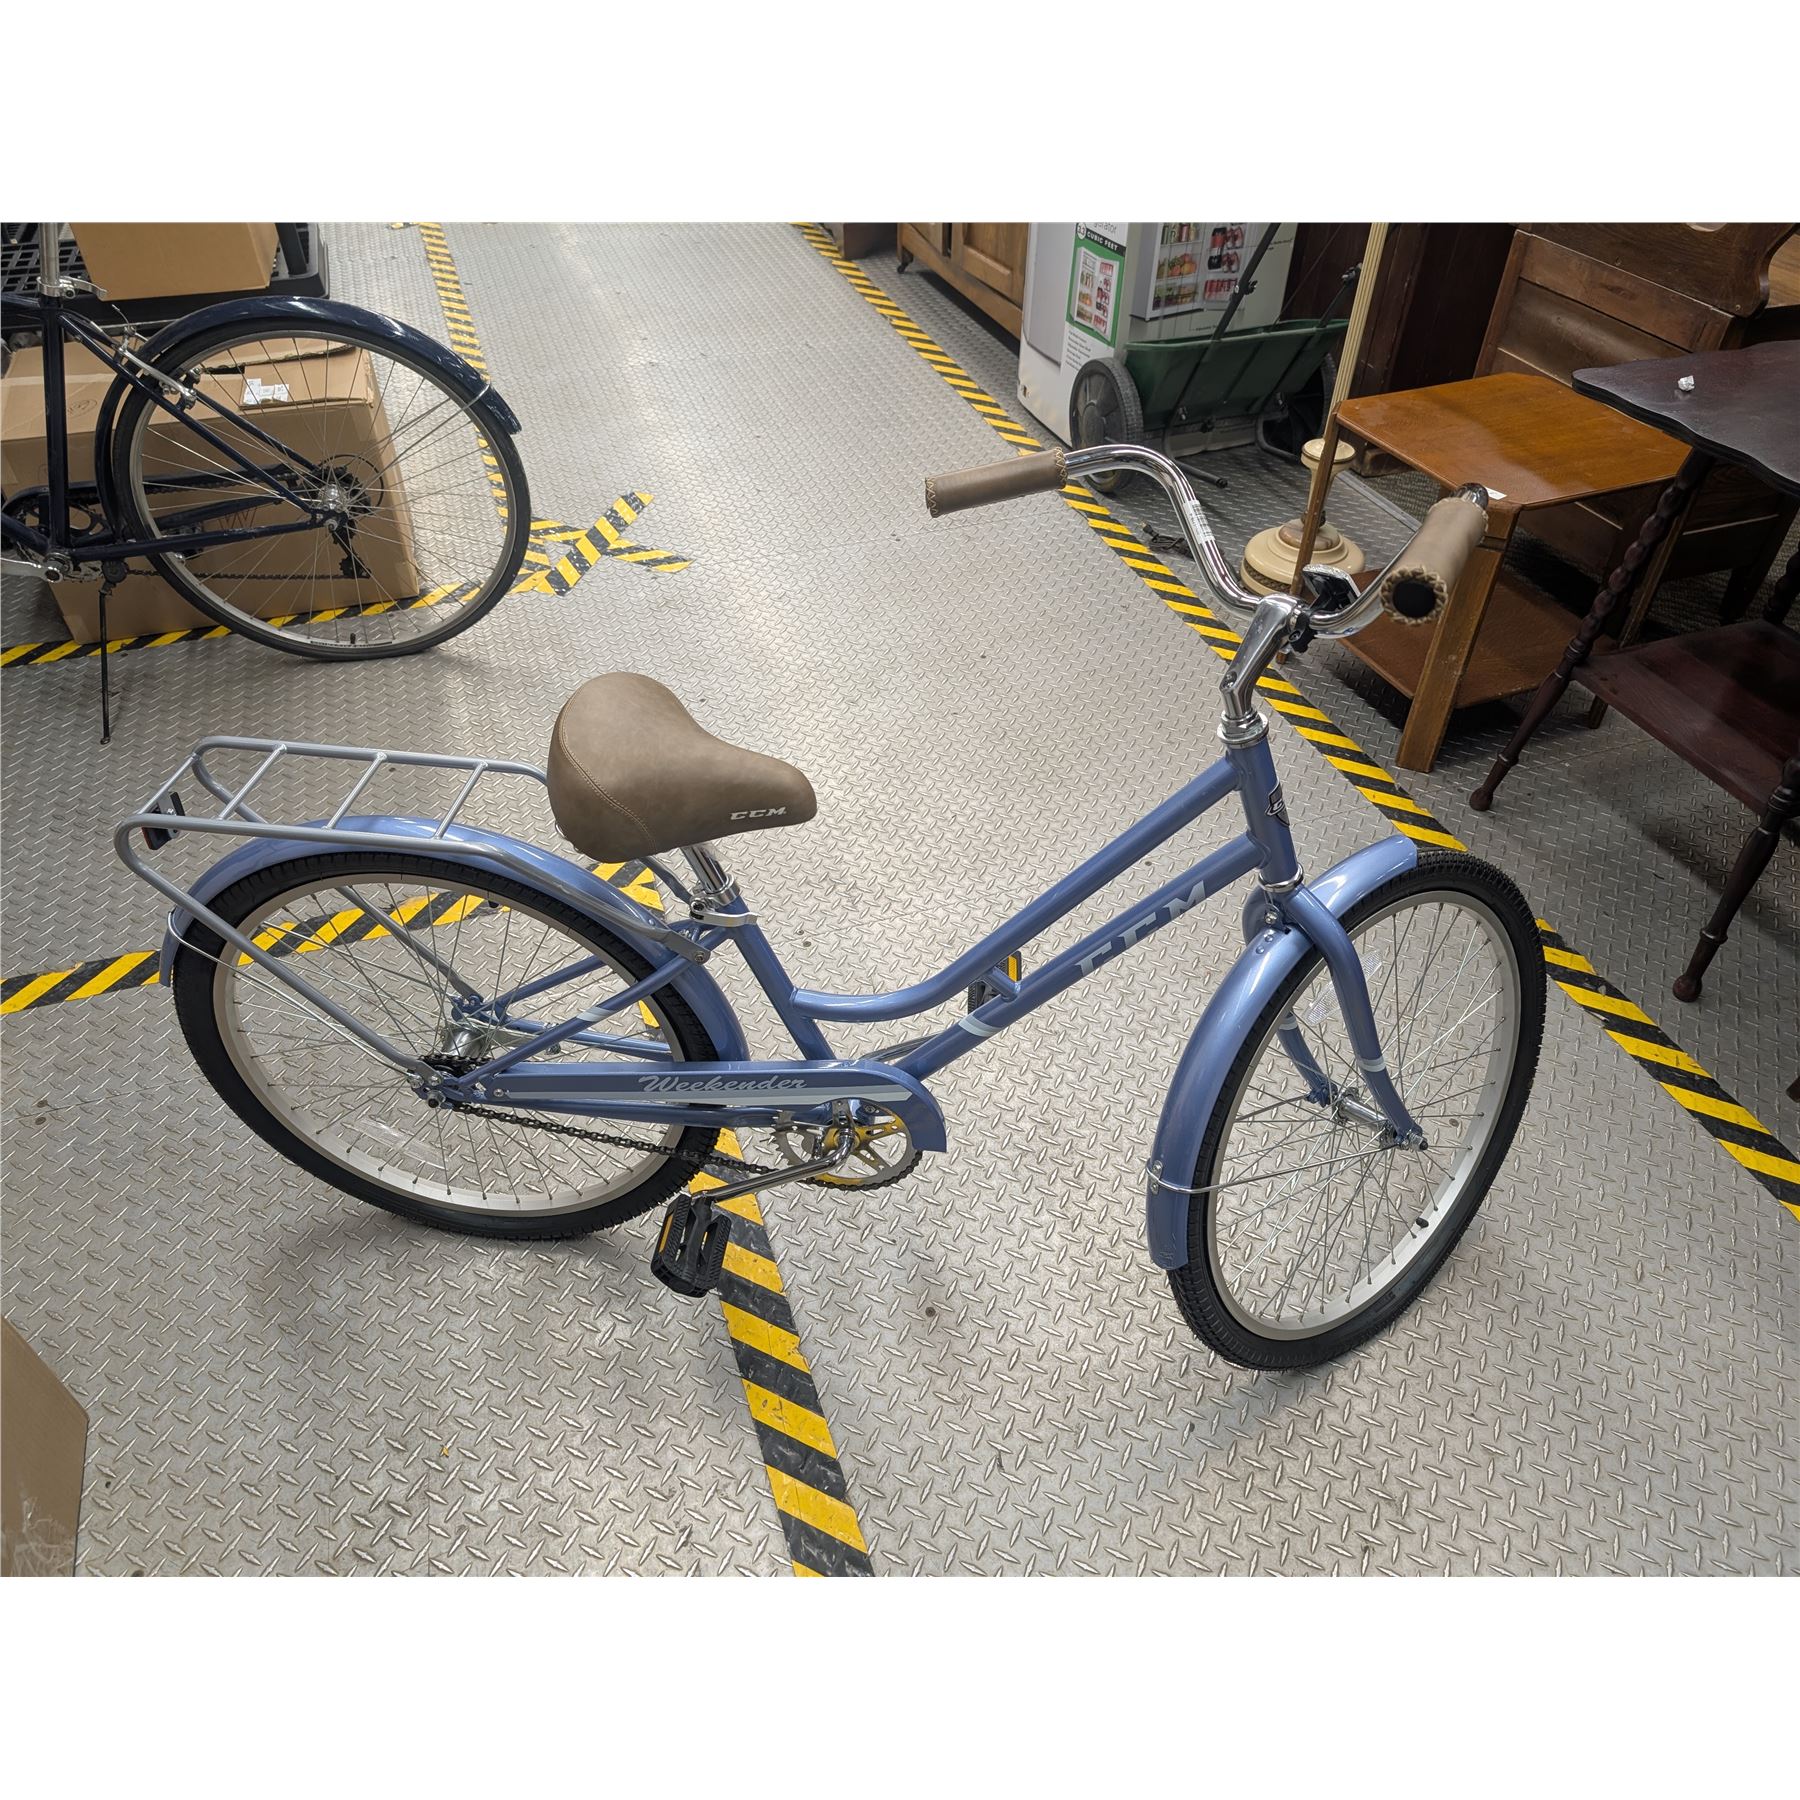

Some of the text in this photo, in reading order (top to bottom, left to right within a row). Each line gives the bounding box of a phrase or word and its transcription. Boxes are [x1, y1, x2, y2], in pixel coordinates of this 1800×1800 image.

[1086, 231, 1104, 244] CUBIC
[1104, 239, 1118, 251] FEET
[730, 806, 786, 820] CCM
[638, 1075, 807, 1092] Weekender
